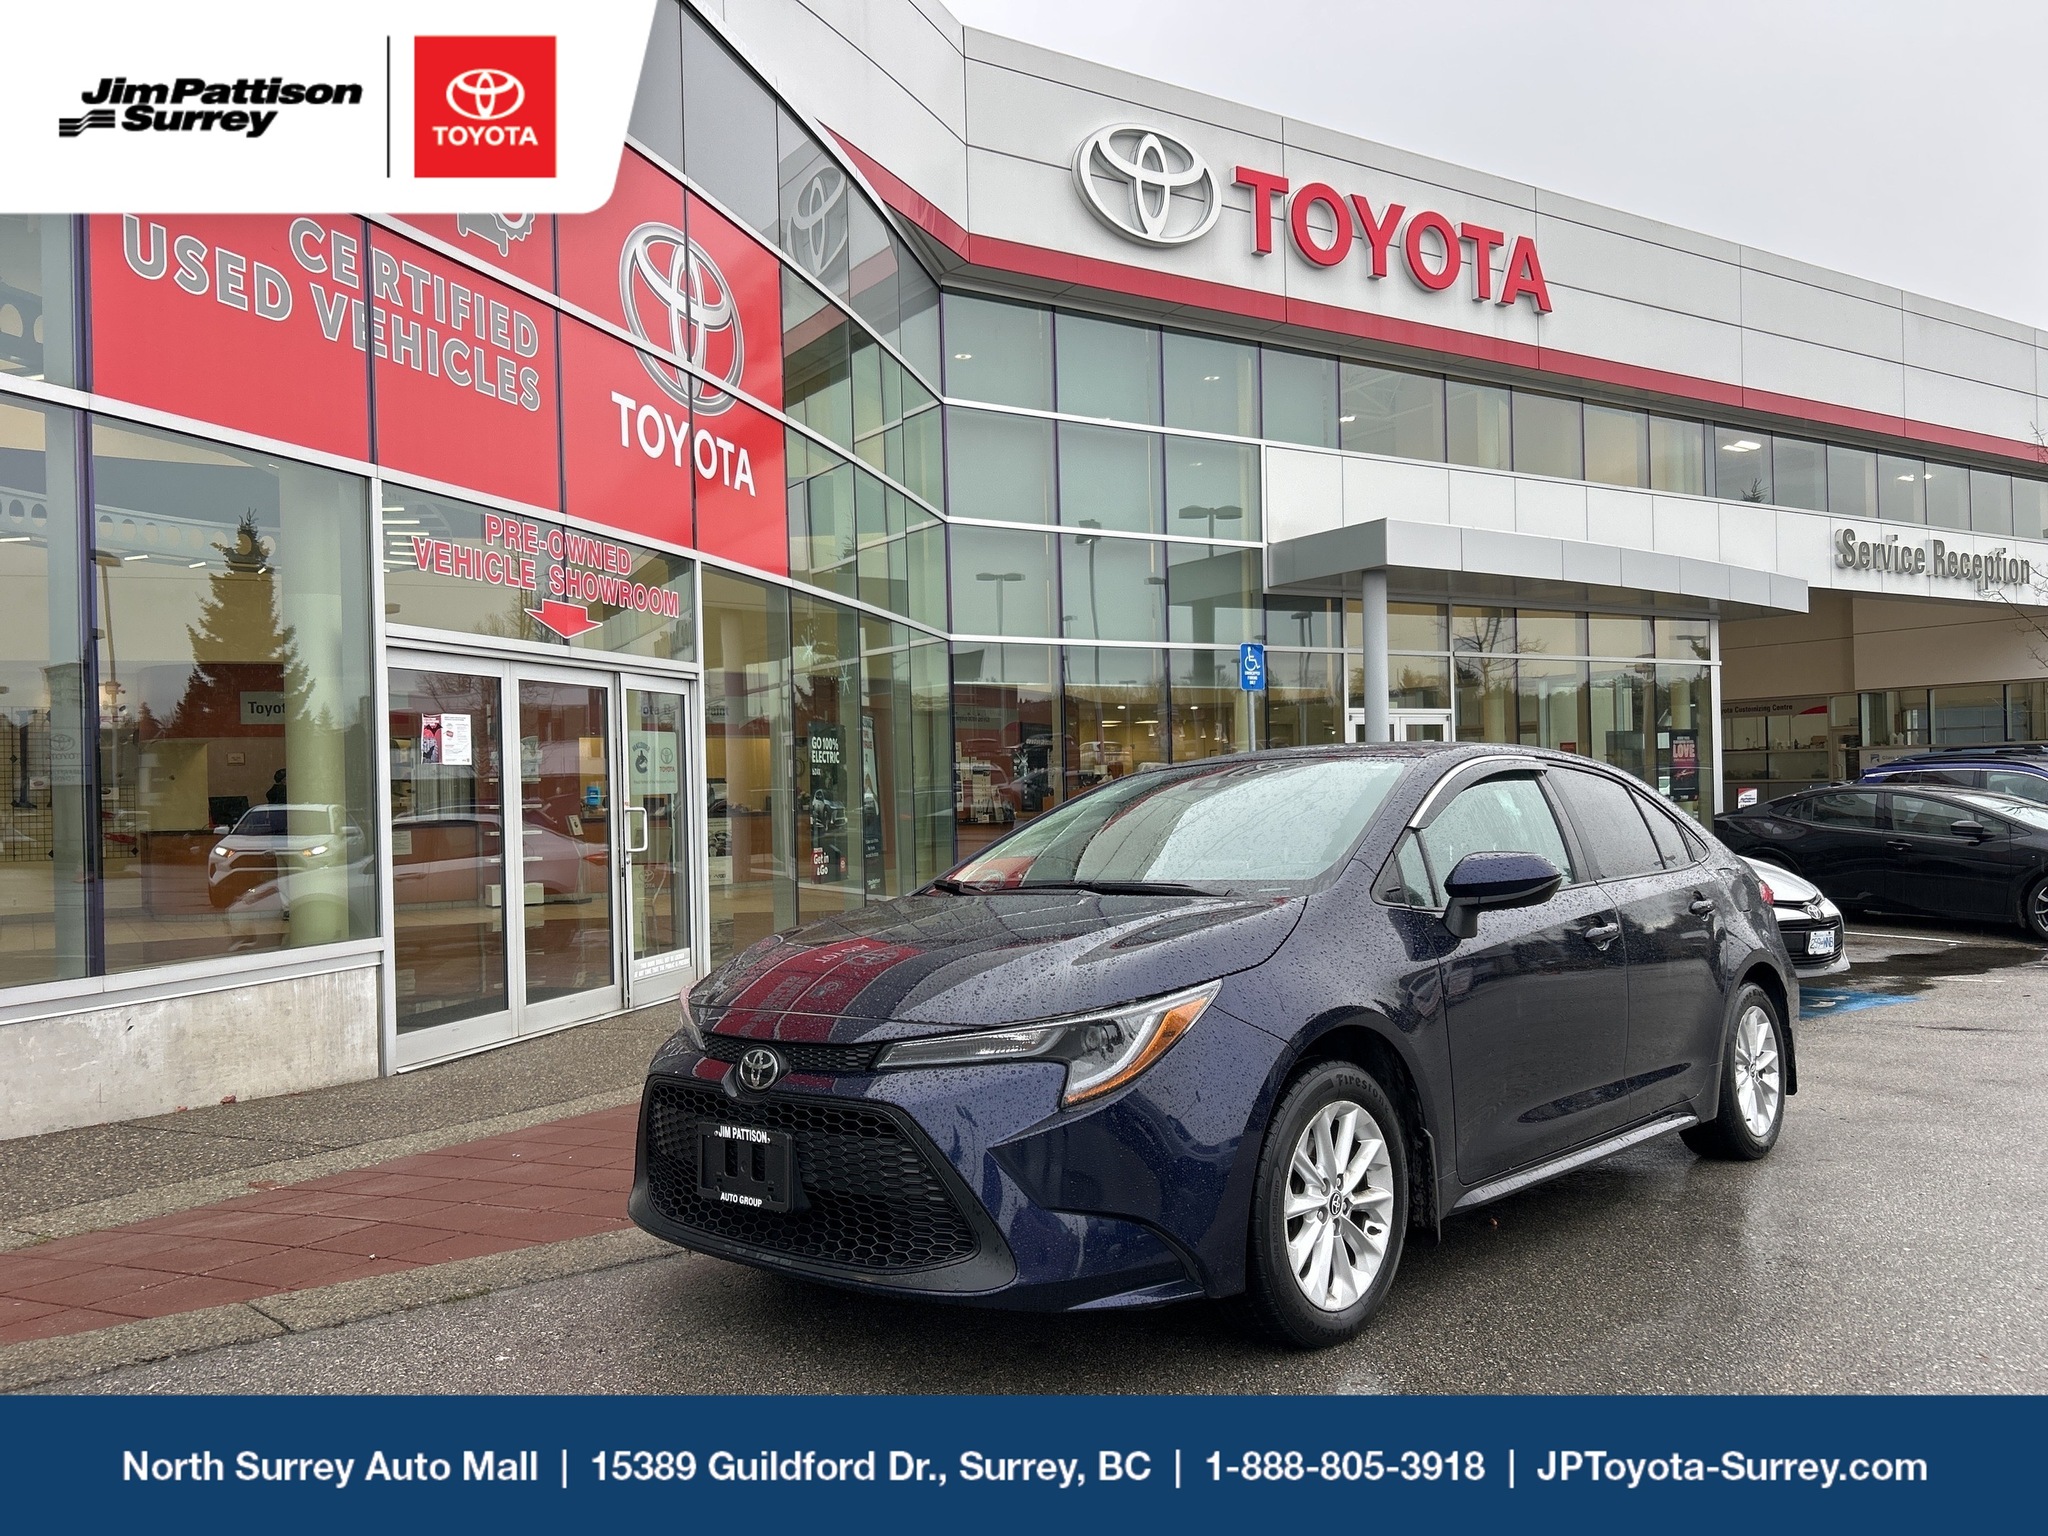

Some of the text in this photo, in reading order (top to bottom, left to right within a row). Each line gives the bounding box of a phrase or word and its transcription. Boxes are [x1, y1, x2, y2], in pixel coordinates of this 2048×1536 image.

[1230, 165, 1552, 315] TOYOTA
[288, 217, 539, 358] CERTIFIED
[122, 213, 540, 412] USED VEHICLES
[611, 390, 756, 498] TOYOTA
[484, 513, 632, 576] PRE-OWNED
[1834, 528, 2030, 592] Service Reception
[411, 536, 680, 619] VEHICLE SHOWROOM
[1734, 704, 1771, 714] Customizing
[1772, 703, 1793, 712] Centre
[811, 736, 839, 751] GO 100%
[811, 750, 840, 764] ELECTRIC
[1672, 743, 1696, 758] LOVE
[813, 852, 830, 865] Get in
[1336, 1073, 1390, 1114] Firestone
[718, 1125, 768, 1144] JIM PATTISON
[720, 1192, 763, 1208] AUTO GROUP
